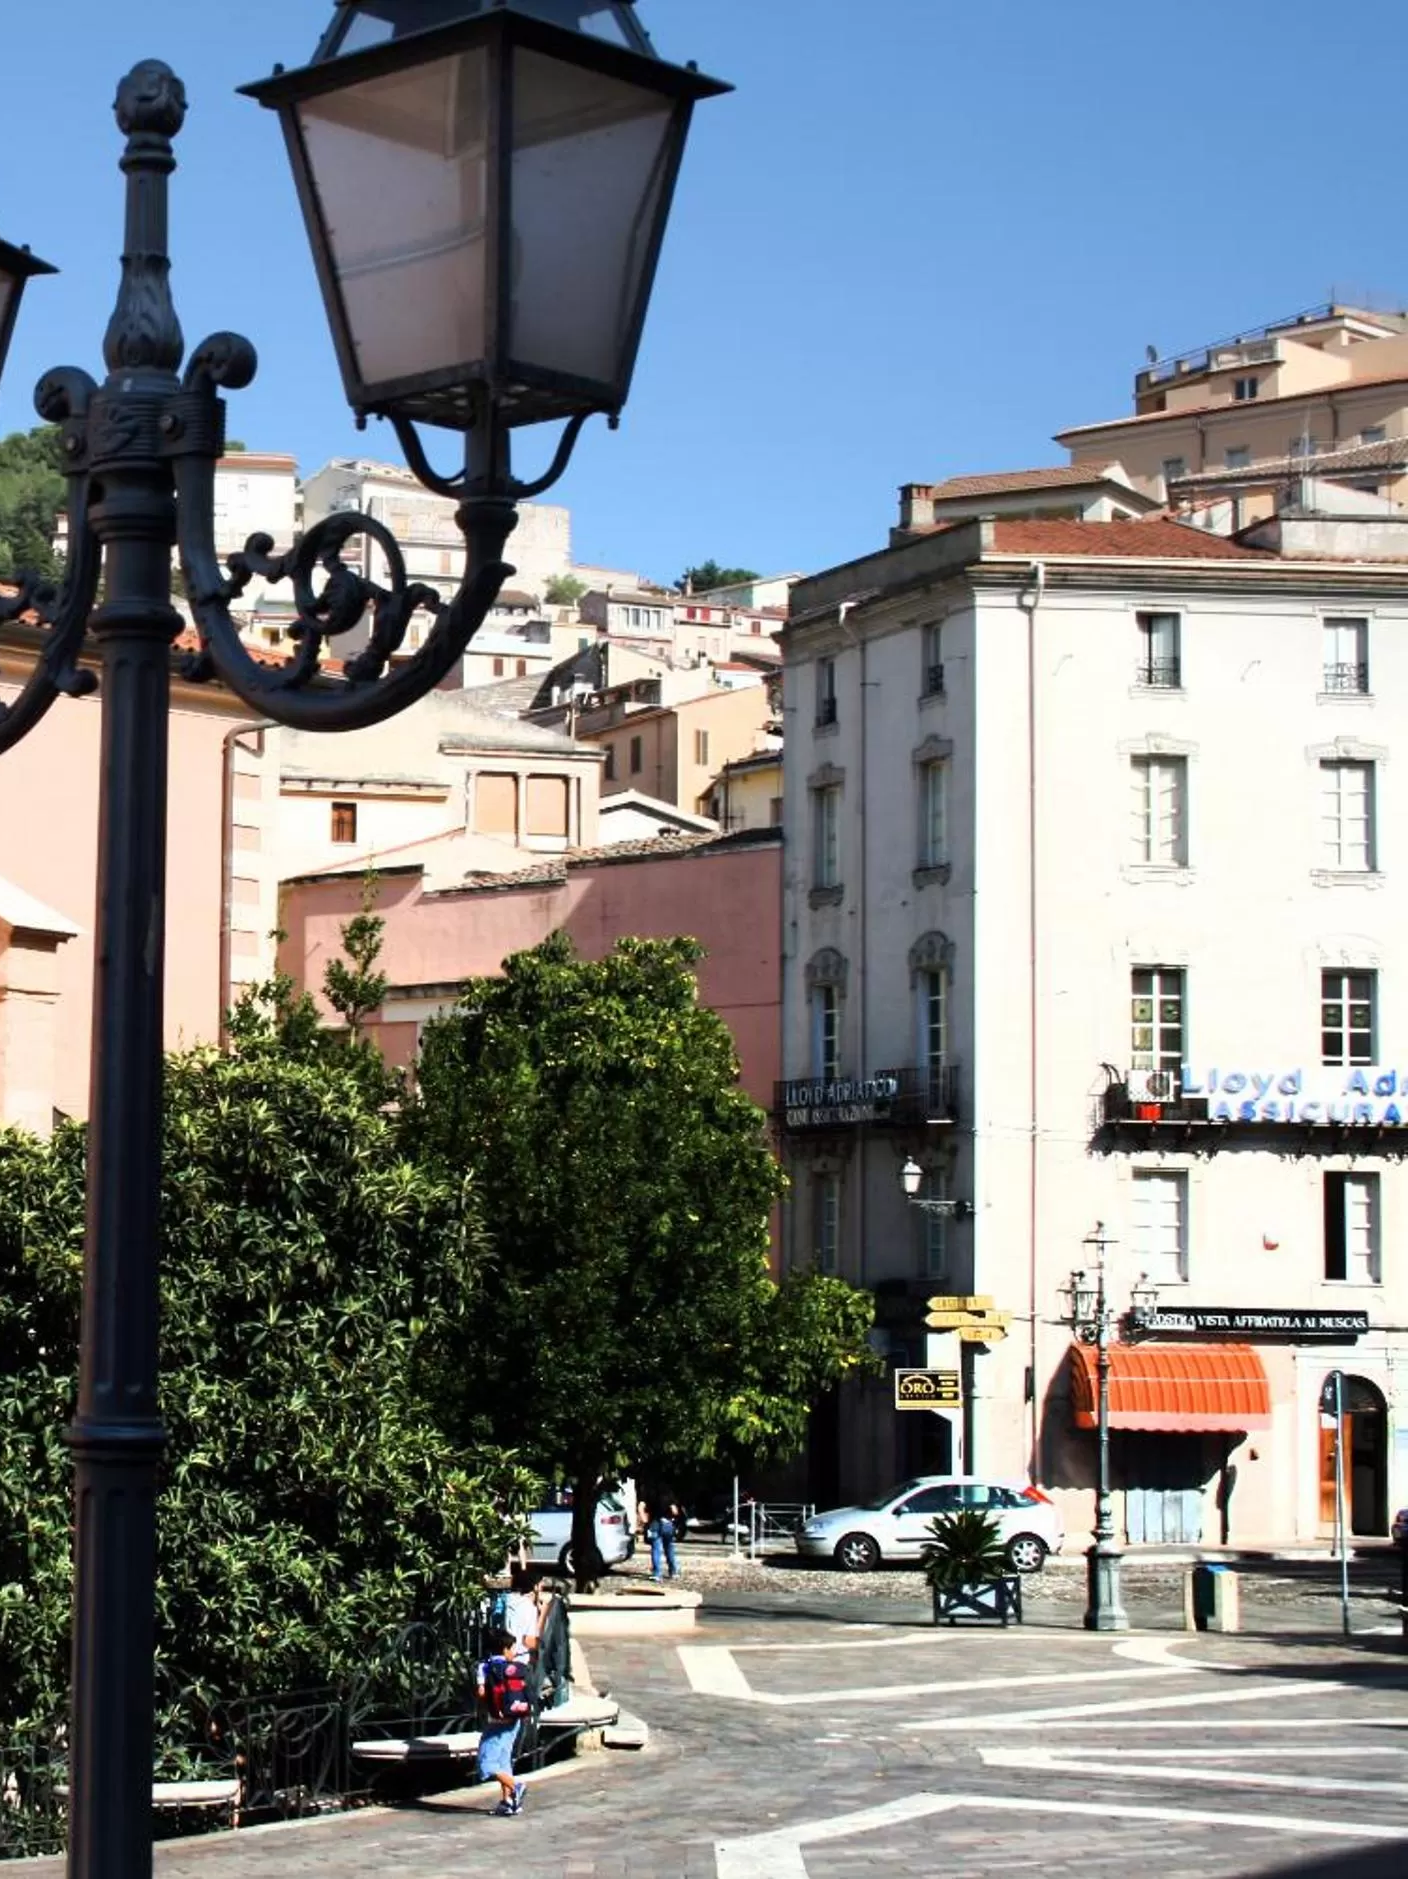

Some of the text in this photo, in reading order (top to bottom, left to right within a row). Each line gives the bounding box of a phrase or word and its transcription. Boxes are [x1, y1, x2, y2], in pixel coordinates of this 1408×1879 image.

[1182, 1066, 1301, 1100] Lloyd
[1197, 1314, 1231, 1327] VISTA
[1232, 1314, 1302, 1328] AFFIDATELA
[1303, 1317, 1317, 1328] AI
[1318, 1316, 1368, 1329] MUSCAS
[900, 1382, 936, 1394] ORO
